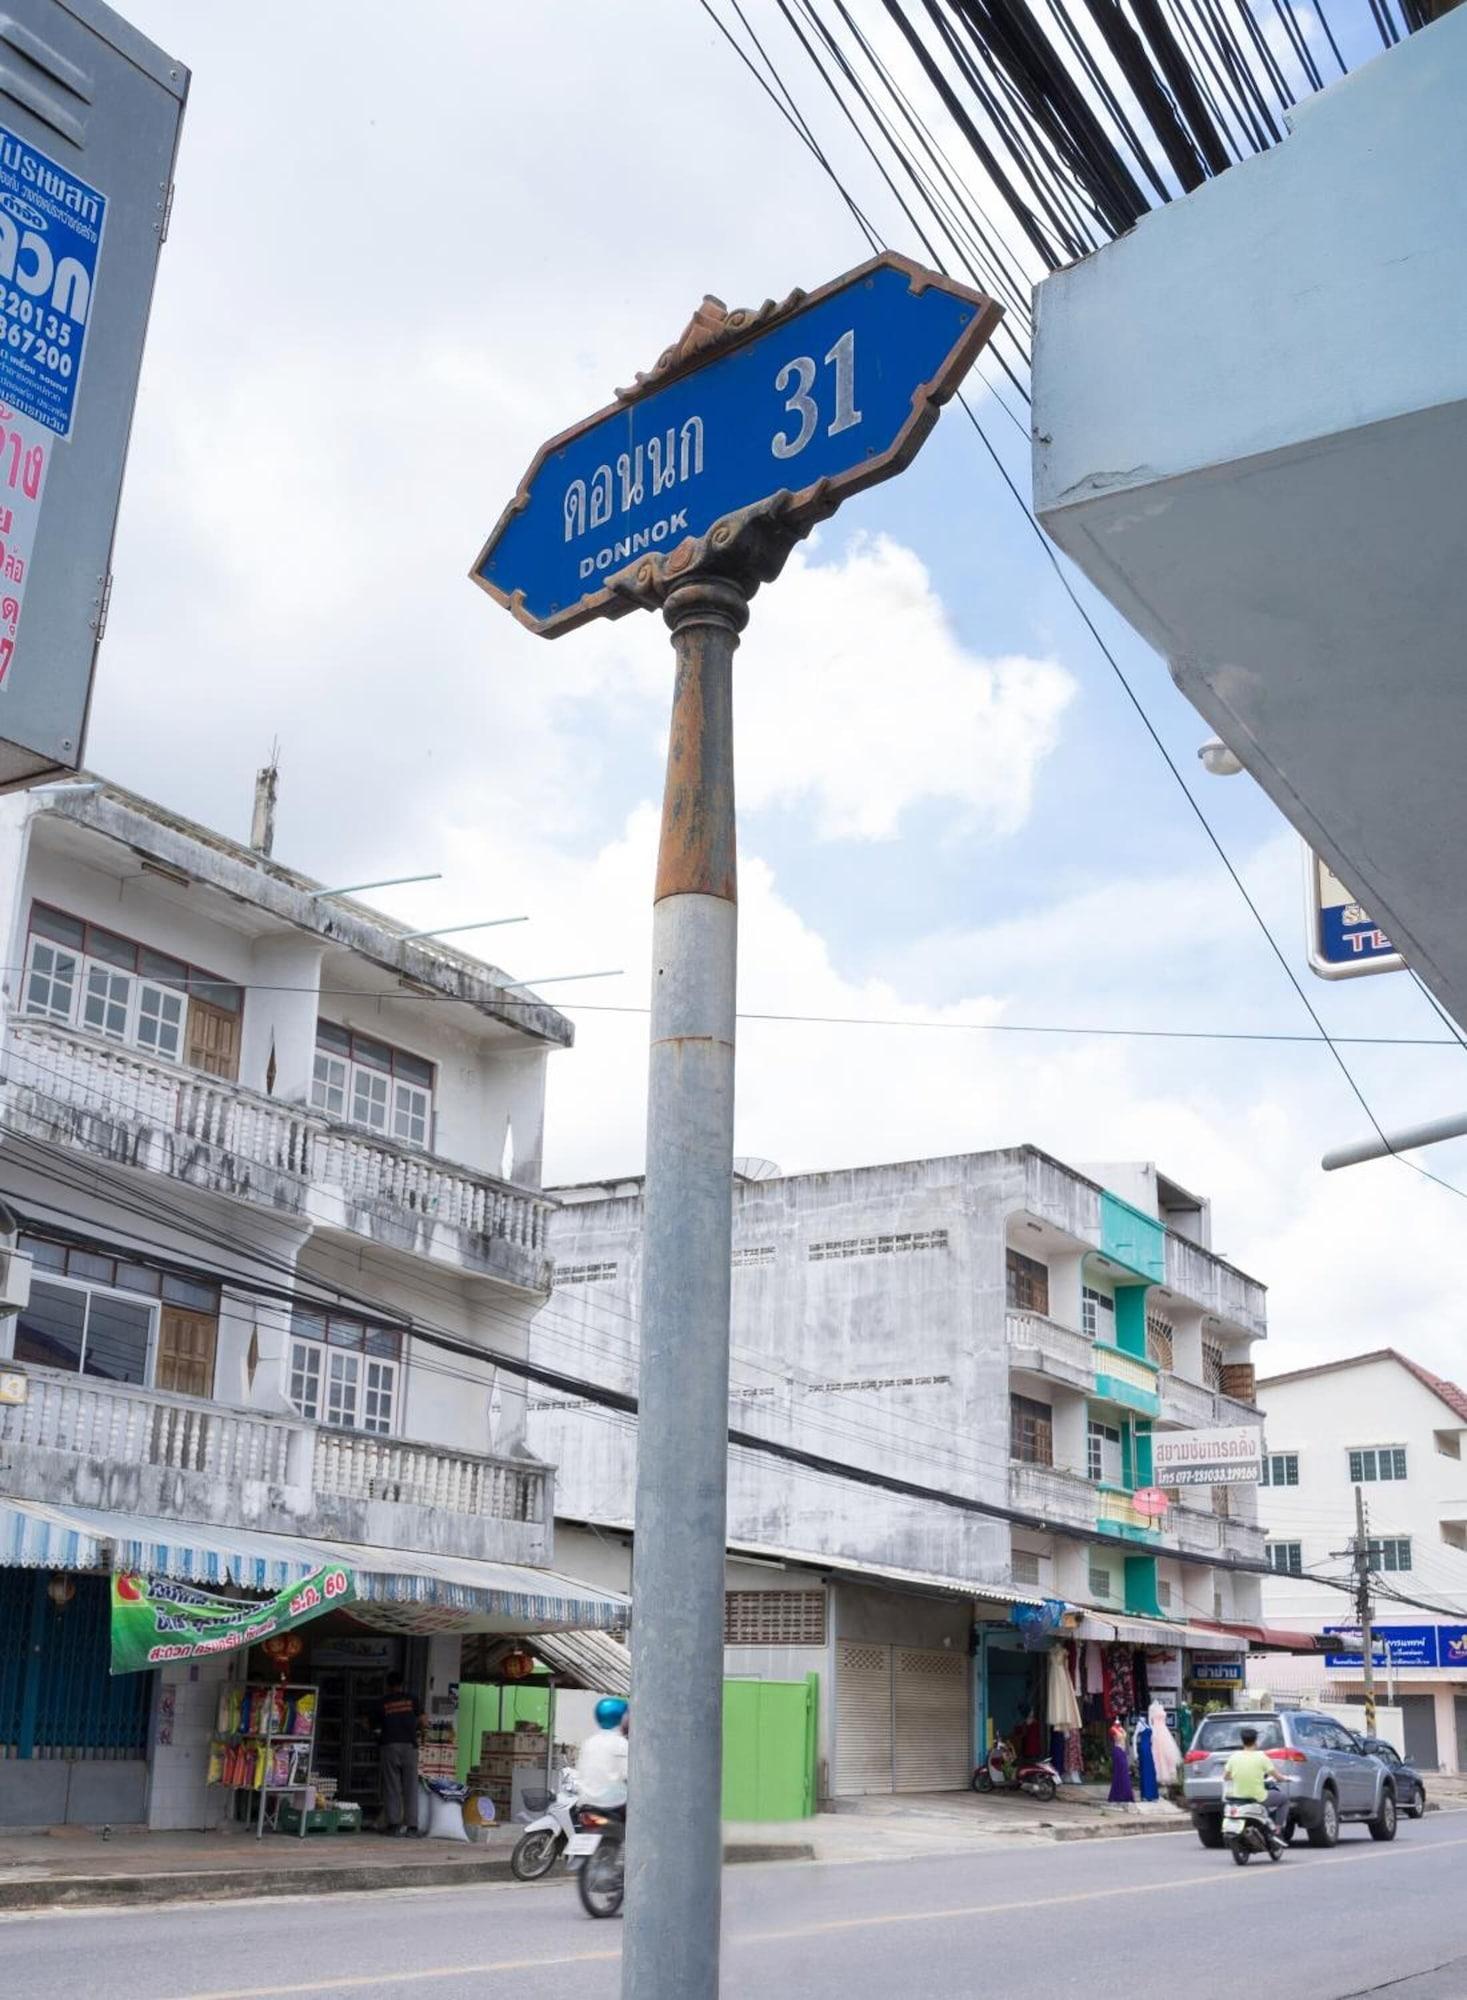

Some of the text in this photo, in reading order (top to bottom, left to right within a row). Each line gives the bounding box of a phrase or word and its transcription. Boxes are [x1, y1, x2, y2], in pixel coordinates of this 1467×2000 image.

[563, 329, 863, 543] ดอนนก 31
[579, 508, 689, 579] DONNOK
[325, 1571, 347, 1597] 60
